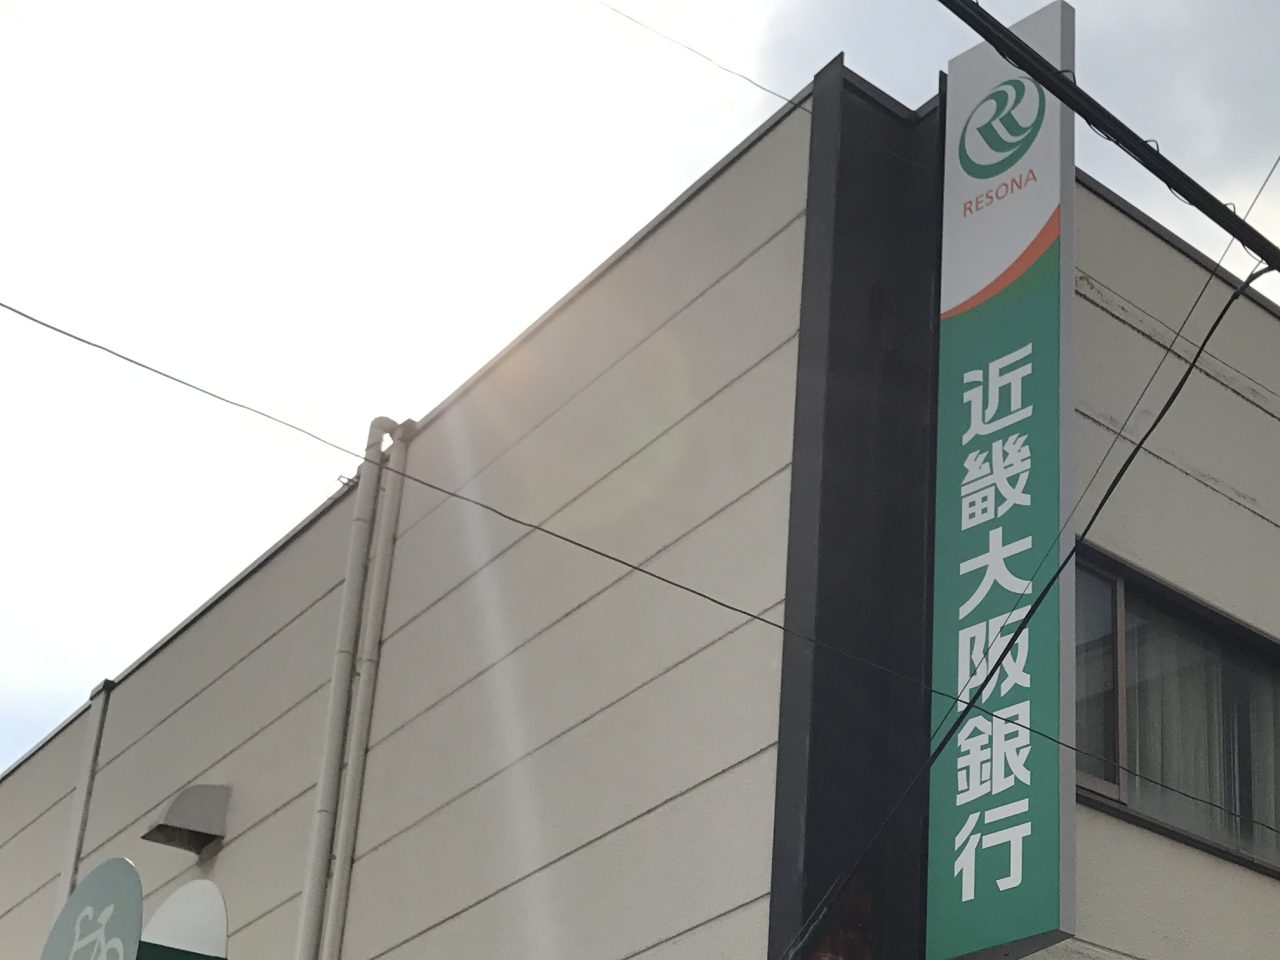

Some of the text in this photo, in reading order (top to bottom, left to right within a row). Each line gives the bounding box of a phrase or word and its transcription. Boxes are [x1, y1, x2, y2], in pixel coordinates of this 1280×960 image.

[962, 168, 1038, 218] RESONA
[953, 341, 1034, 904] 近畿大阪銀行
